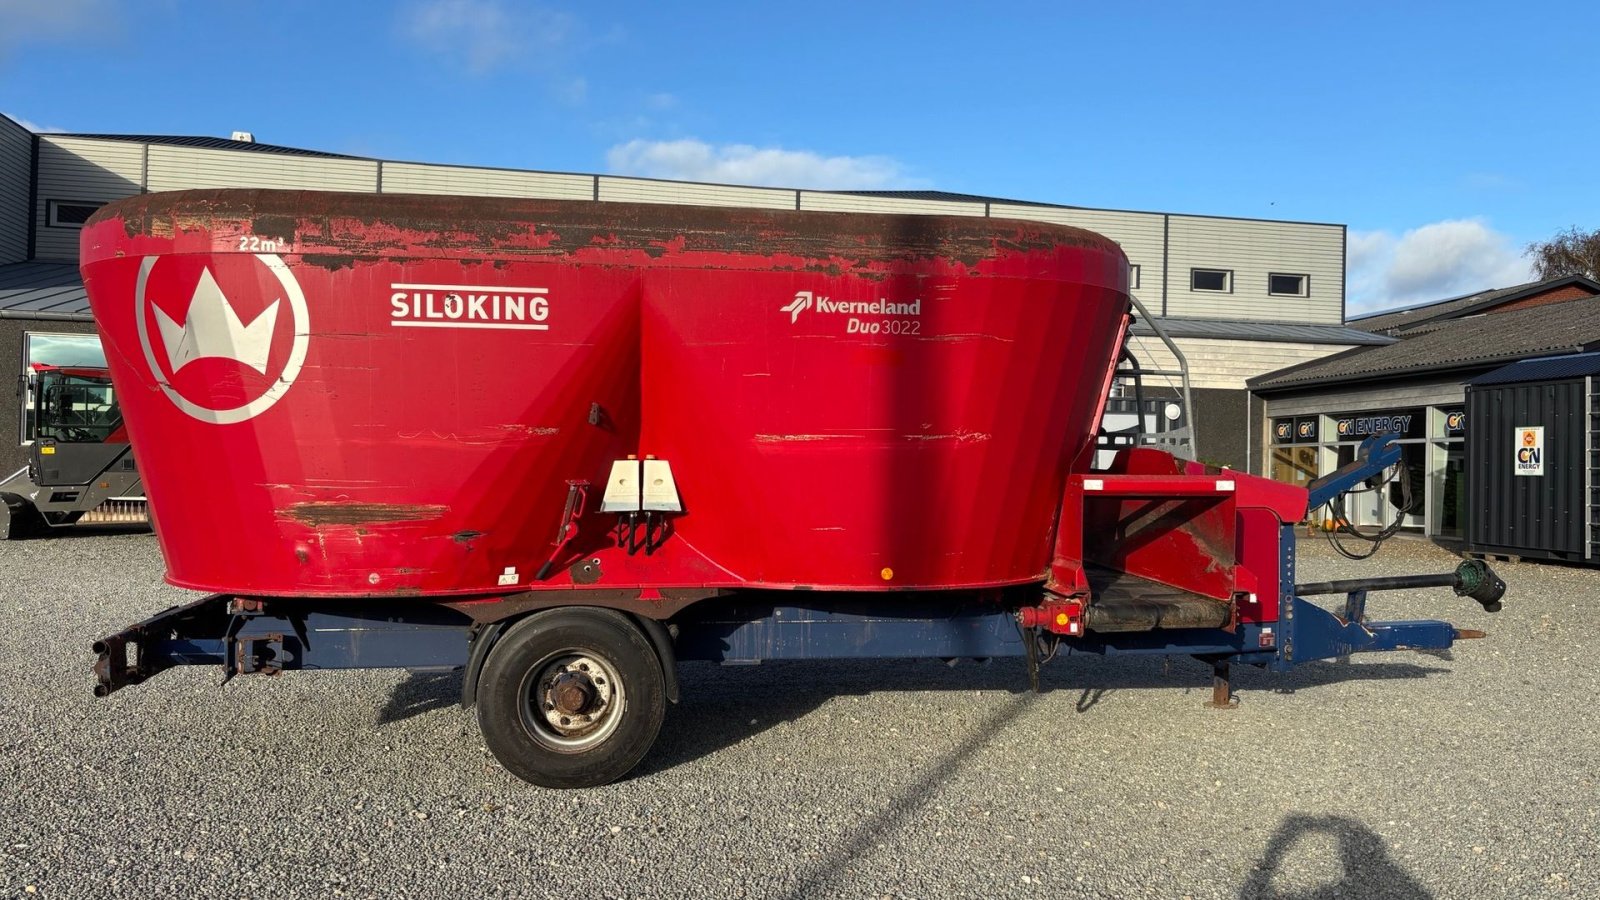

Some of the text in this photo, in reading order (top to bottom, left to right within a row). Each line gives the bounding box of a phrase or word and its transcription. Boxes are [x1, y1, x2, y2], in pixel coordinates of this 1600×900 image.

[391, 292, 549, 321] SILOKING
[816, 296, 921, 315] Kverneland
[847, 318, 921, 335] Duo 3022
[1355, 415, 1412, 434] ENERGY
[1518, 447, 1541, 463] CN
